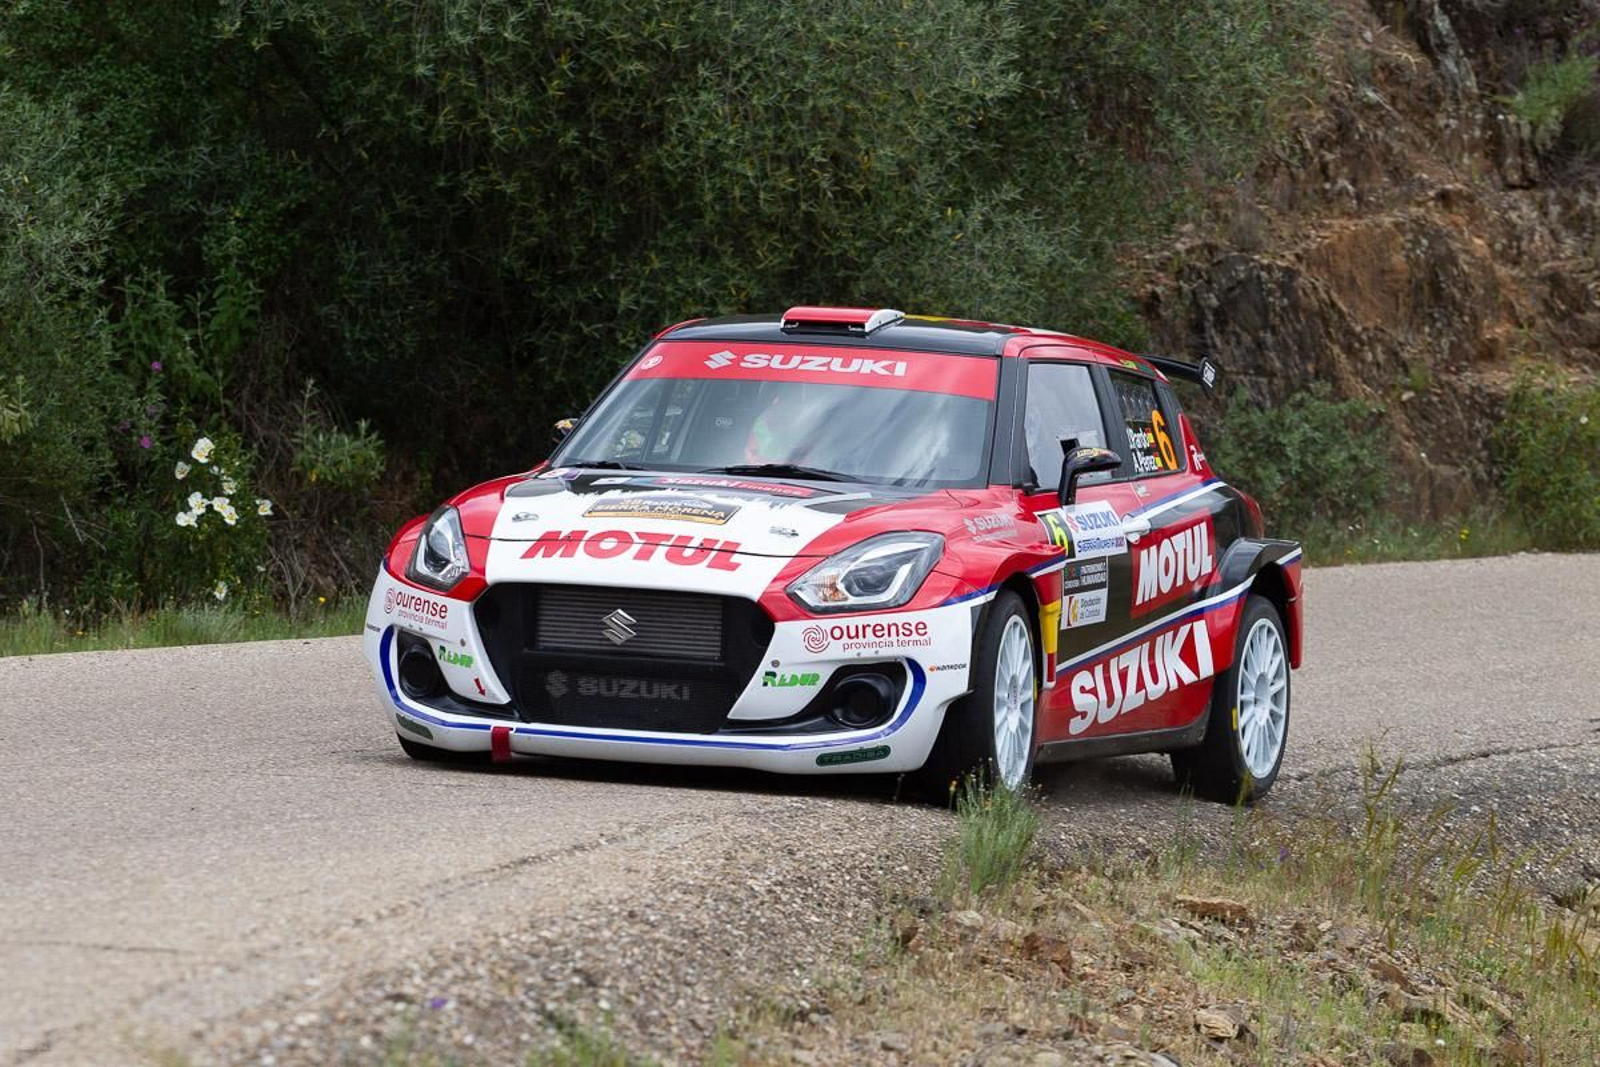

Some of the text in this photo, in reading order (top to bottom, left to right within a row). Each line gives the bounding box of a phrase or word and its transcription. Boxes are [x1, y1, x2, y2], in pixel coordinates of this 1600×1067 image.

[739, 353, 907, 377] SUZUKI
[1151, 410, 1178, 470] 6
[1075, 510, 1120, 531] SUZUKI
[520, 529, 743, 572] MOTUL
[1135, 521, 1213, 606] MOTUL
[395, 591, 448, 619] ourense
[398, 608, 448, 630] provincia termal
[830, 621, 928, 641] ourense
[843, 637, 932, 651] provincia termal
[577, 676, 690, 701] SUZUKI
[1069, 619, 1214, 736] SUZUKI
